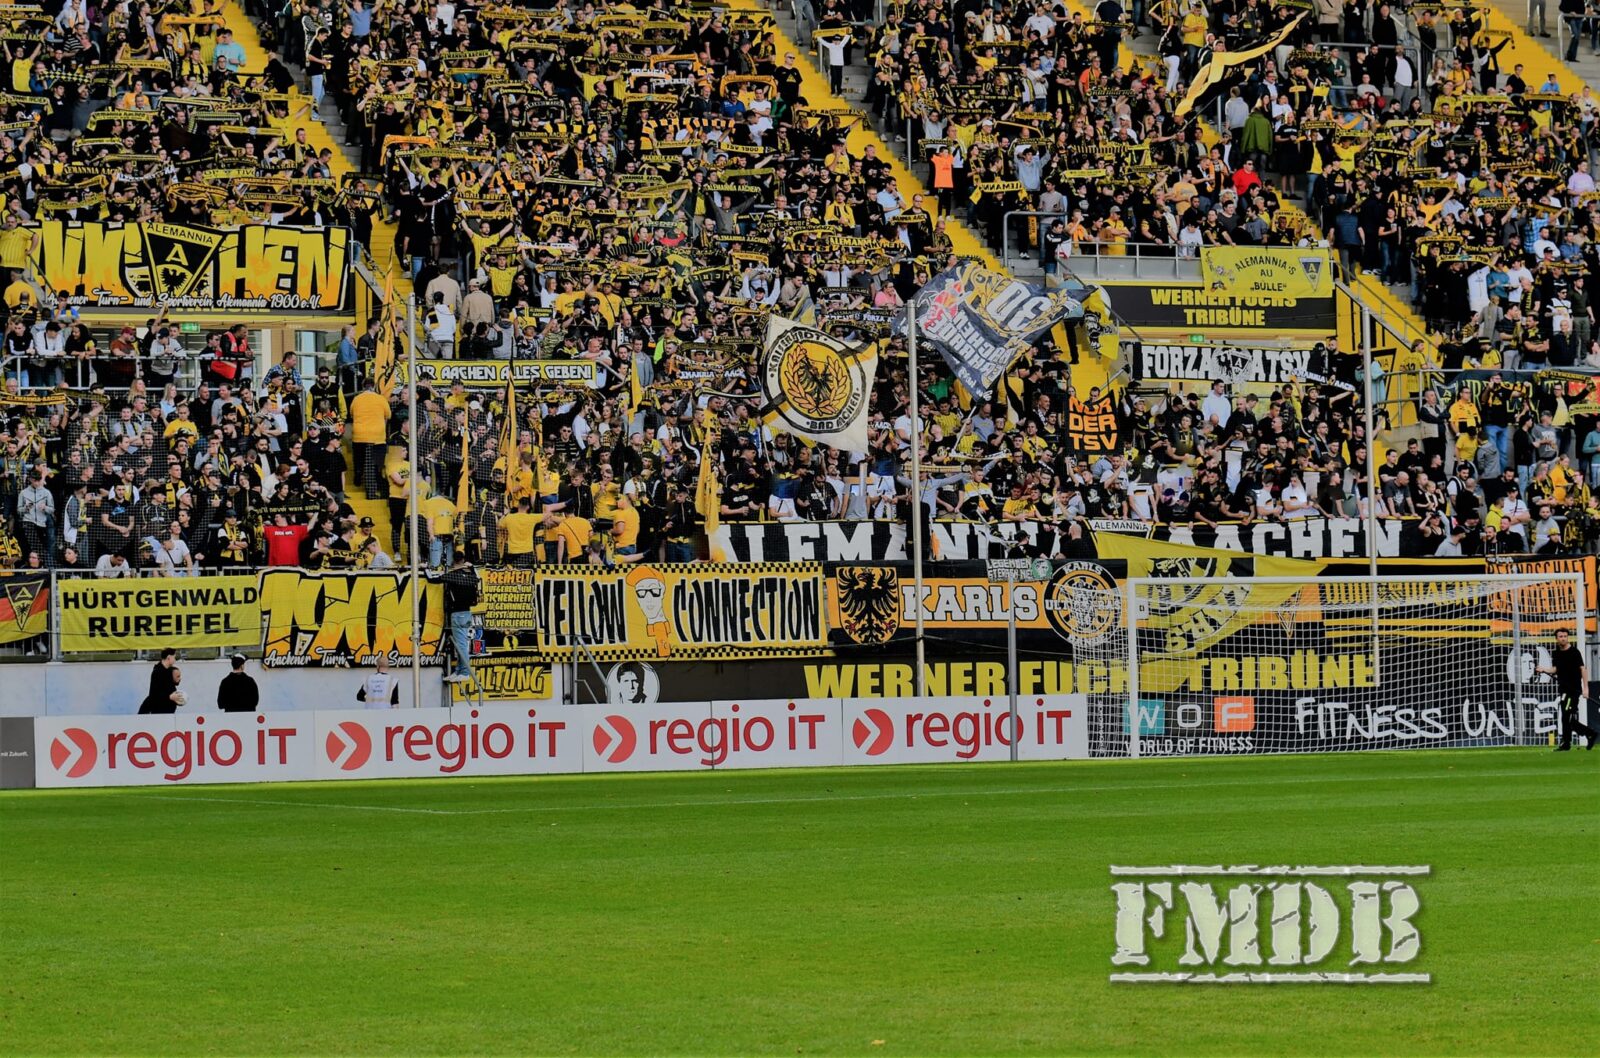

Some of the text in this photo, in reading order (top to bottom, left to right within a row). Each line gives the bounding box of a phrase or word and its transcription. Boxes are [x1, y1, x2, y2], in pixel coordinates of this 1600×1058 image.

[146, 222, 214, 245] ALEMANNIA
[164, 243, 189, 266] A
[1260, 268, 1273, 278] AU
[216, 293, 267, 308] Alemannia
[270, 294, 299, 309] 1900
[1183, 307, 1266, 327] TRIBÜNE
[417, 362, 593, 380] ÜR AACHEN ALLES GEBEN!
[1142, 346, 1312, 383] FORZA ATSV
[1069, 394, 1113, 414] NUR
[810, 421, 834, 430] BAD
[1069, 413, 1117, 432] DER
[1069, 432, 1118, 451] TSV
[1093, 520, 1150, 532] ALEMANNIA
[986, 559, 1032, 569] LEGENDEN
[1062, 561, 1104, 575] KARLS
[485, 570, 532, 584] FREIHEIT
[15, 586, 33, 600] A
[62, 587, 259, 610] HÜRTGENWALD
[484, 594, 532, 603] SICHERHEIT
[901, 584, 1037, 622] KARLS
[536, 578, 627, 647] YELLOW
[673, 576, 820, 643] CONNECTION
[88, 612, 240, 639] RUREIFEL
[496, 619, 533, 628] VERLIEREN
[264, 650, 311, 668] Aachener
[316, 647, 355, 667] Turn-
[804, 660, 1005, 699] WERNER
[906, 697, 1072, 759] regio iT
[1295, 696, 1448, 741] FITNESS
[385, 708, 566, 773] regio iT
[648, 702, 826, 766] regio iT
[107, 715, 297, 781] regio iT
[1176, 739, 1195, 753] OF
[1198, 736, 1254, 752] FITNESS
